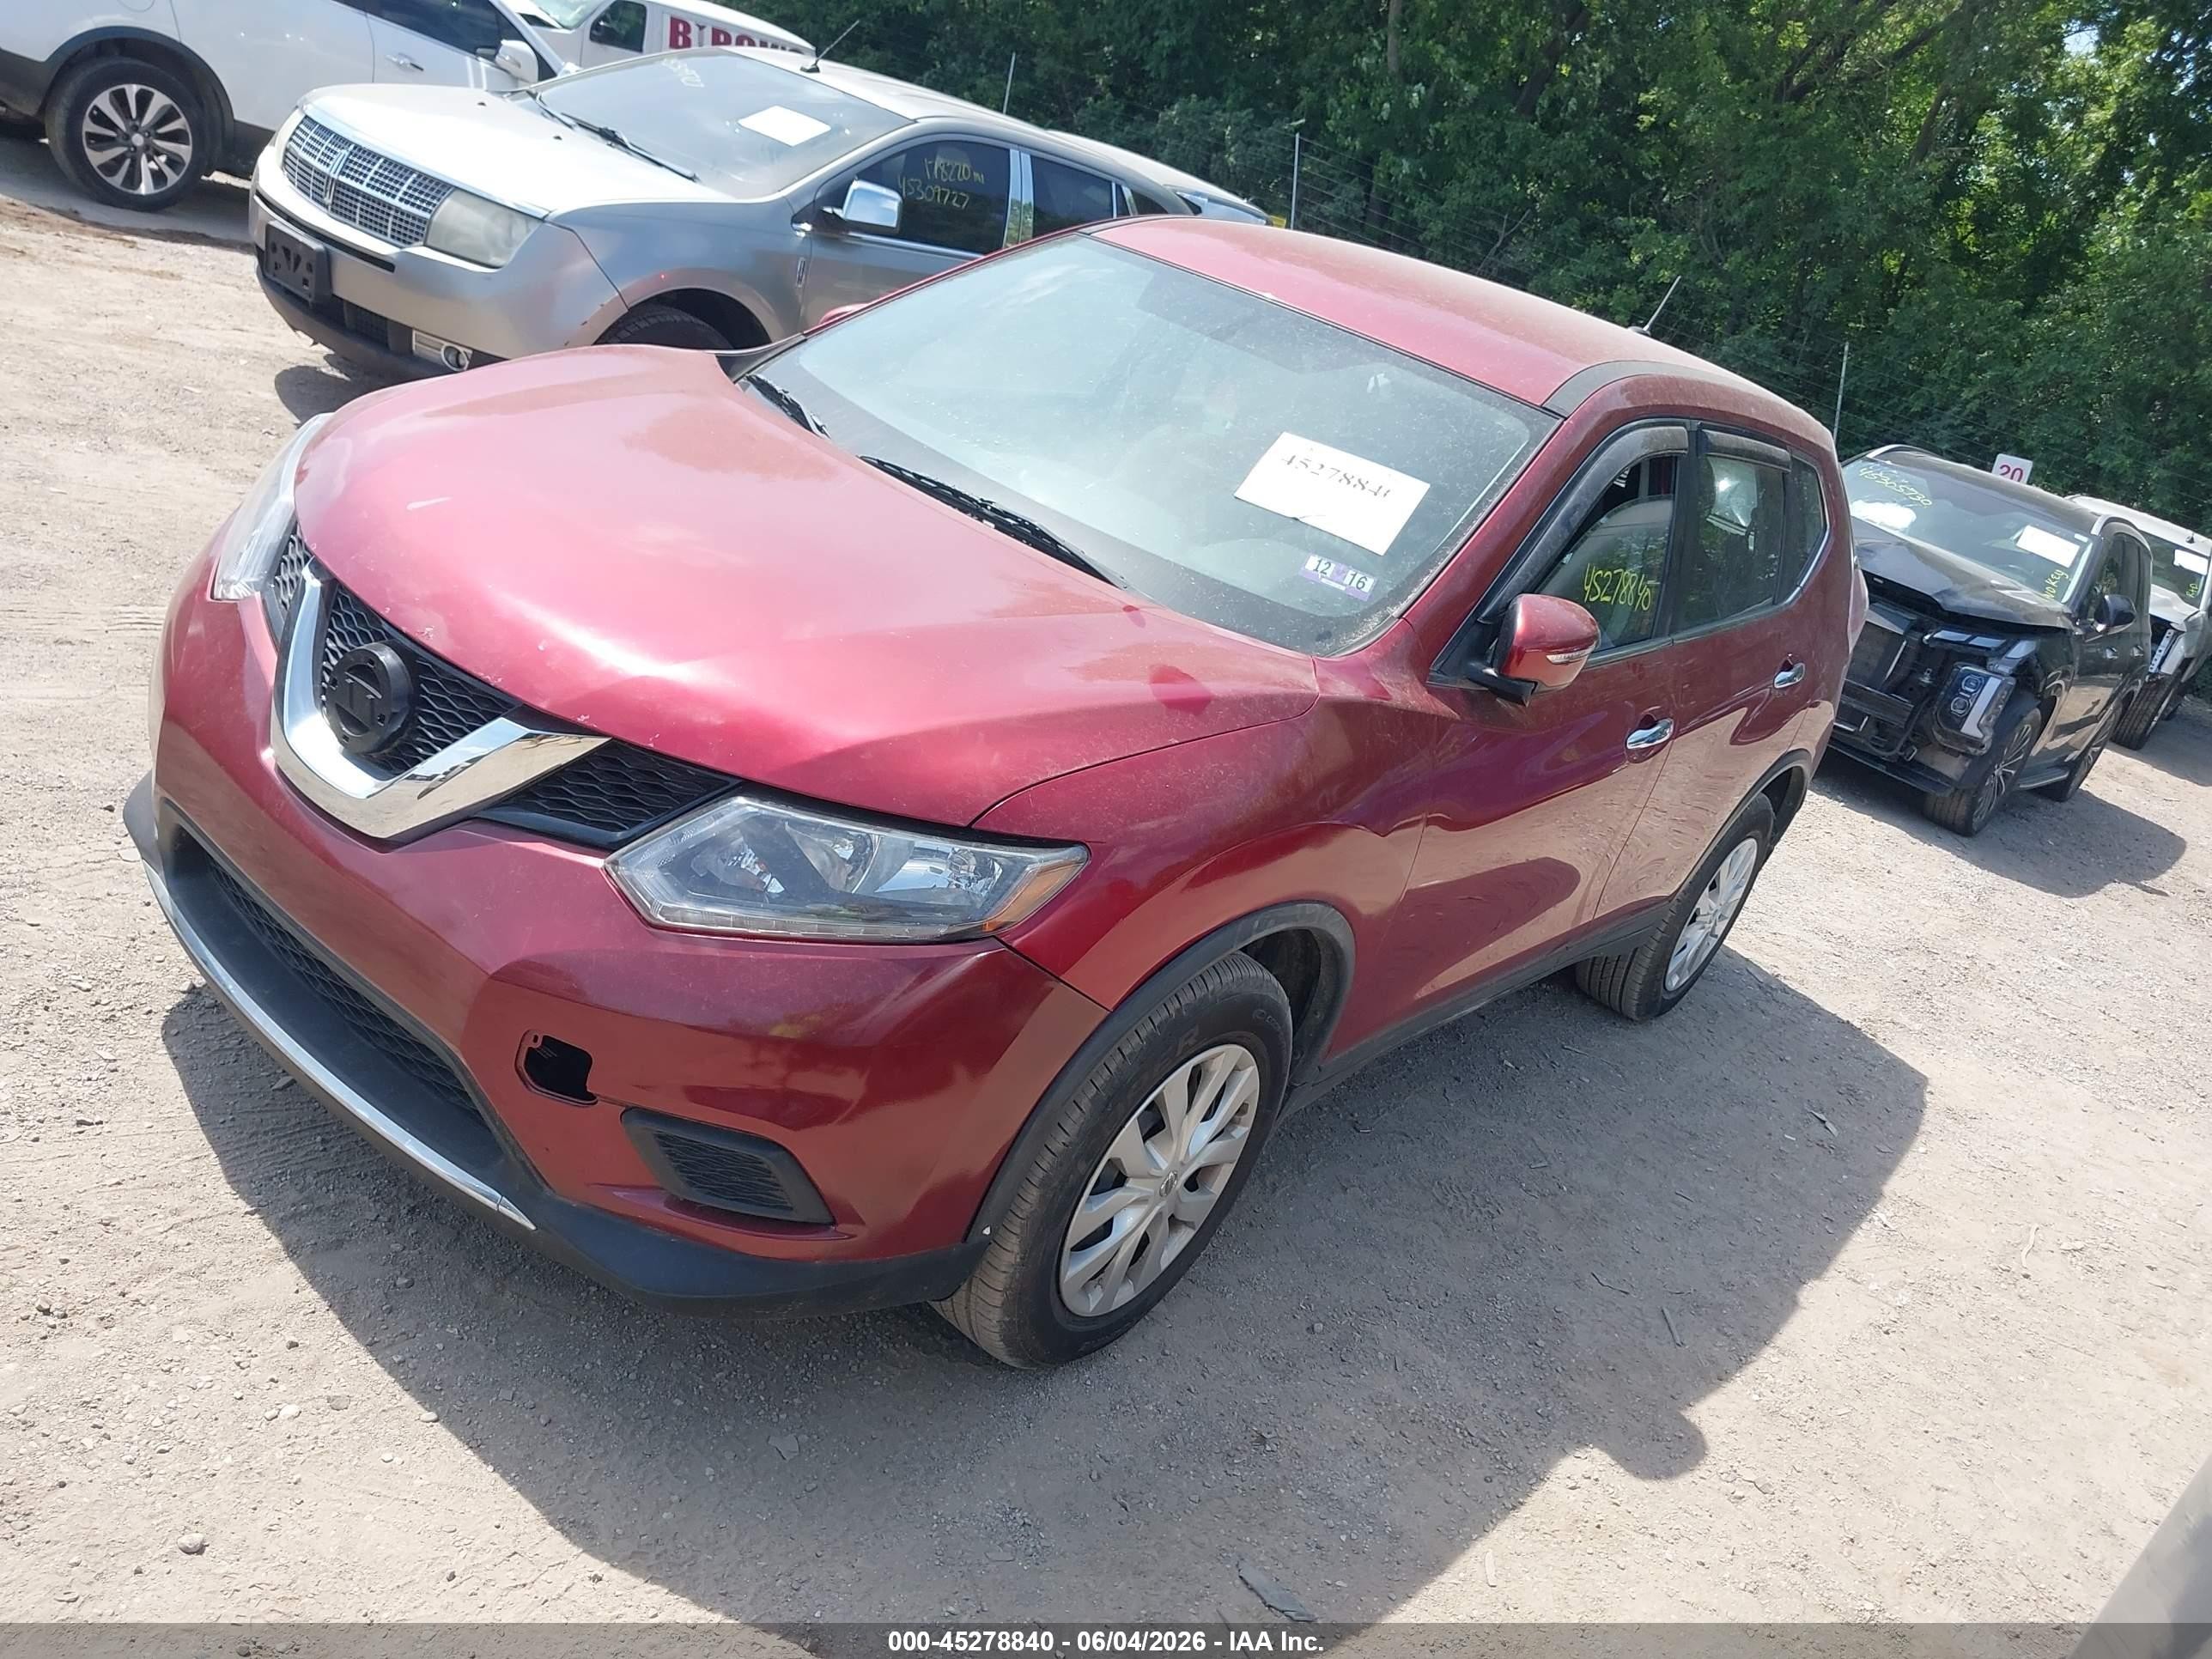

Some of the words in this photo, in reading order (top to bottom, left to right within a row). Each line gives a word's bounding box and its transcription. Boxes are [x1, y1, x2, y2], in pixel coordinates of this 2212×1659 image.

[1279, 453, 1392, 499] 4527884
[1999, 464, 2024, 483] 20
[1313, 558, 1332, 575] 12
[1348, 572, 1368, 591] 16
[1583, 562, 1651, 612] 45278840
